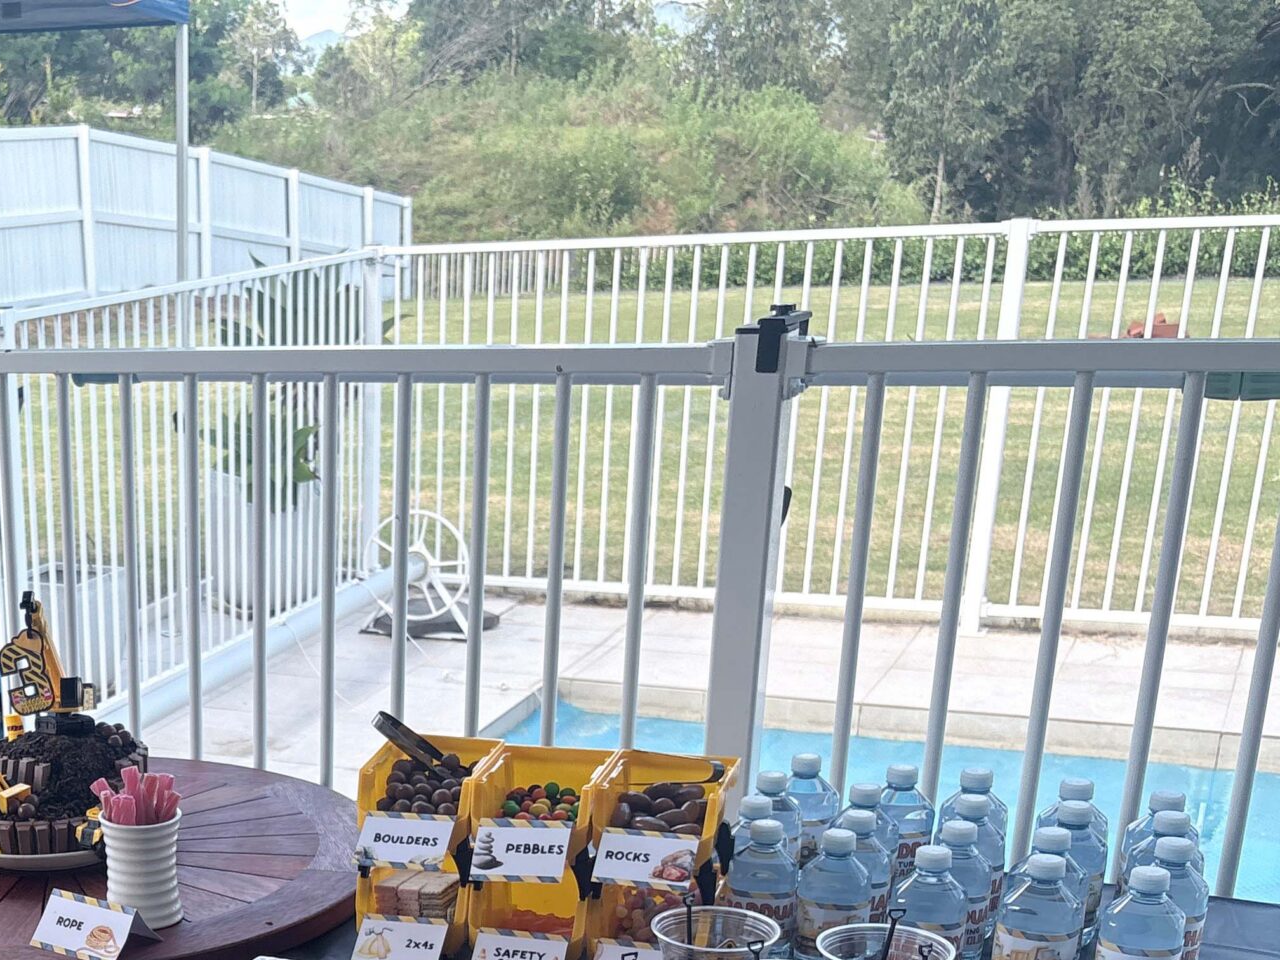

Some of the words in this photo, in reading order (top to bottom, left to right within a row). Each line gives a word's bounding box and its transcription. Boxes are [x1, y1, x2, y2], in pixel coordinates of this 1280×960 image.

[373, 832, 439, 847] BOULDERS
[505, 843, 565, 855] PEBBLES
[605, 850, 651, 863] ROCKS
[56, 916, 84, 931] ROPE
[405, 938, 435, 950] 2x4s
[493, 947, 546, 960] SAFETY
